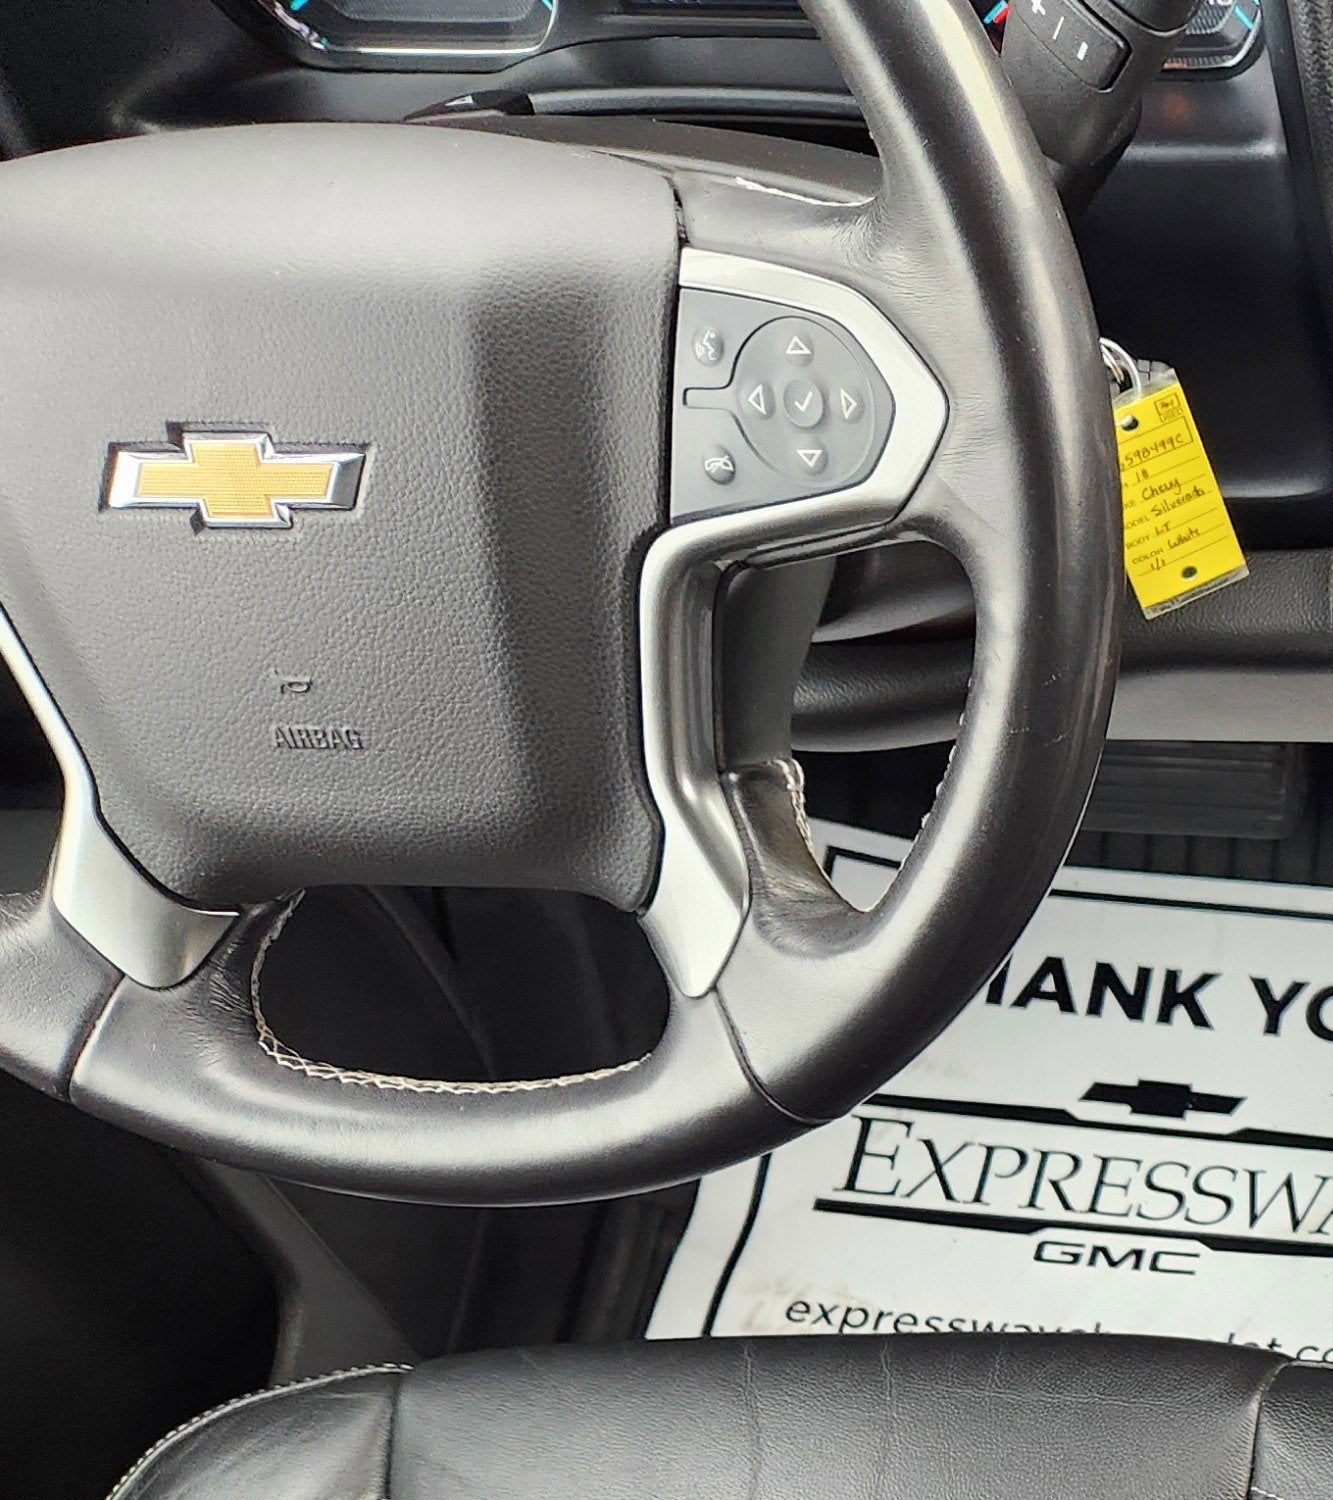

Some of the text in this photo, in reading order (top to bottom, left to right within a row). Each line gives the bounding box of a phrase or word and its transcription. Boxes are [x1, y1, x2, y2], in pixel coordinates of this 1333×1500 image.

[273, 726, 364, 750] AIRBAG
[985, 954, 1224, 1028] ANK
[1032, 1240, 1201, 1277] GMC
